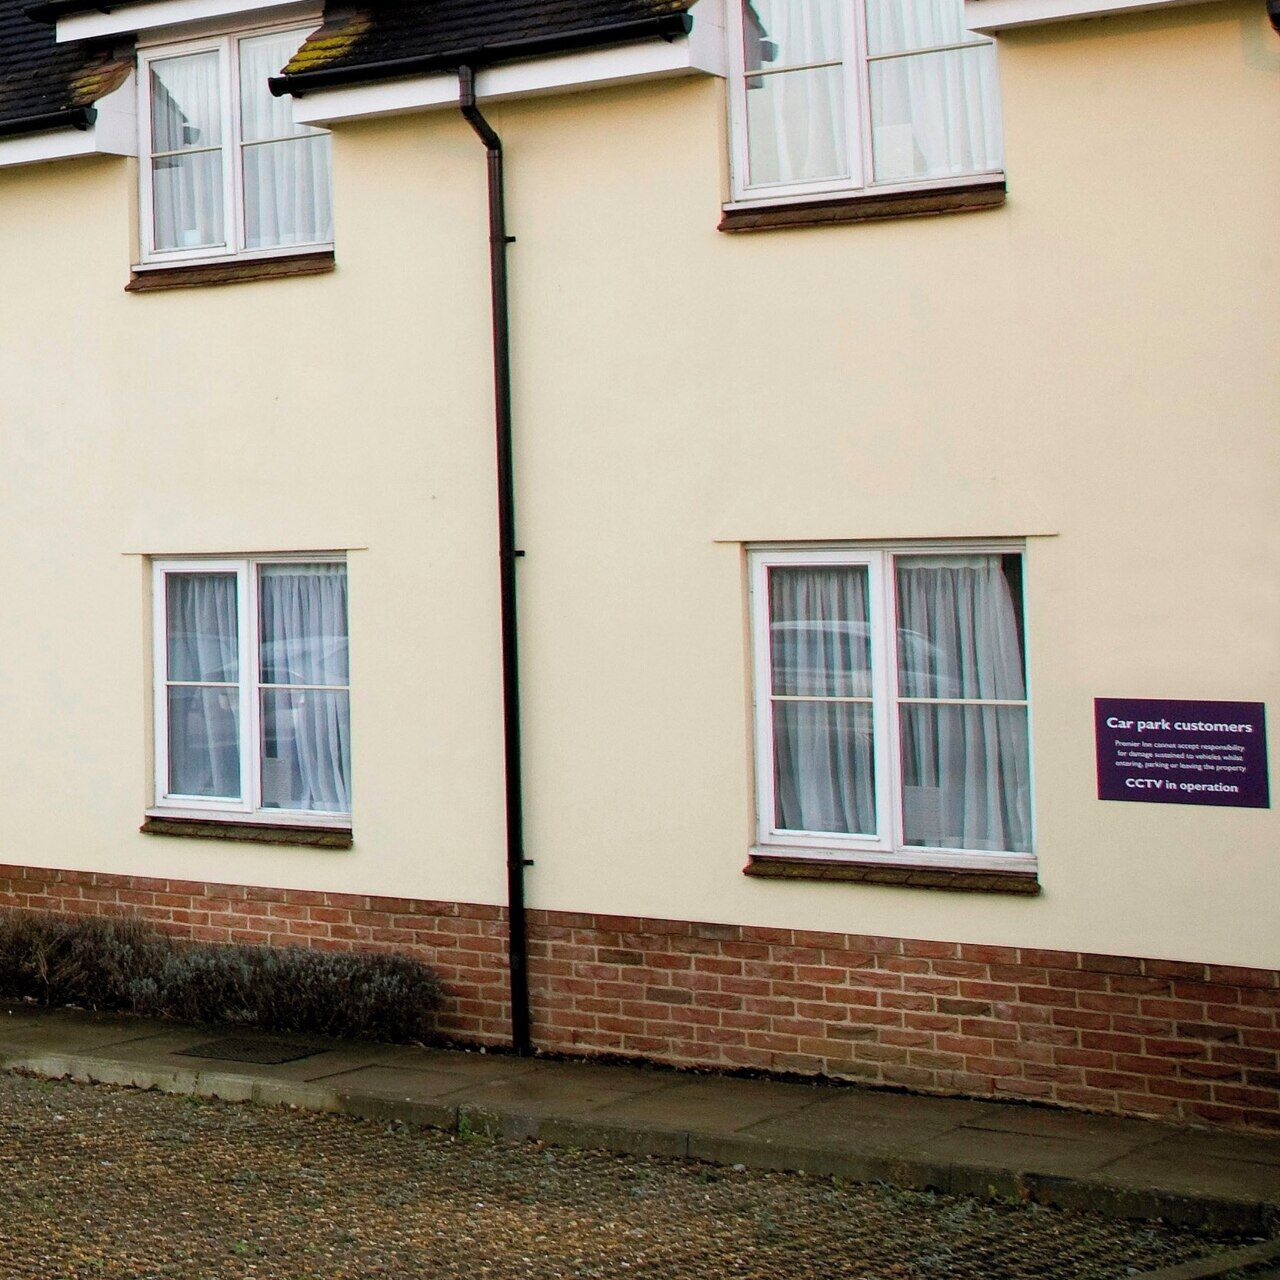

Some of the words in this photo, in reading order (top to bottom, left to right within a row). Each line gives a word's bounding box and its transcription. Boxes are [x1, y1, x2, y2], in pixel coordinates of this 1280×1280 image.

[1106, 717, 1133, 729] Car
[1137, 718, 1171, 732] park
[1173, 721, 1253, 733] customers
[1128, 751, 1153, 759] damage
[1144, 761, 1169, 770] parking
[1179, 762, 1203, 771] leaving
[1125, 778, 1163, 789] CCTV
[1165, 780, 1177, 790] in
[1179, 781, 1239, 793] operation
